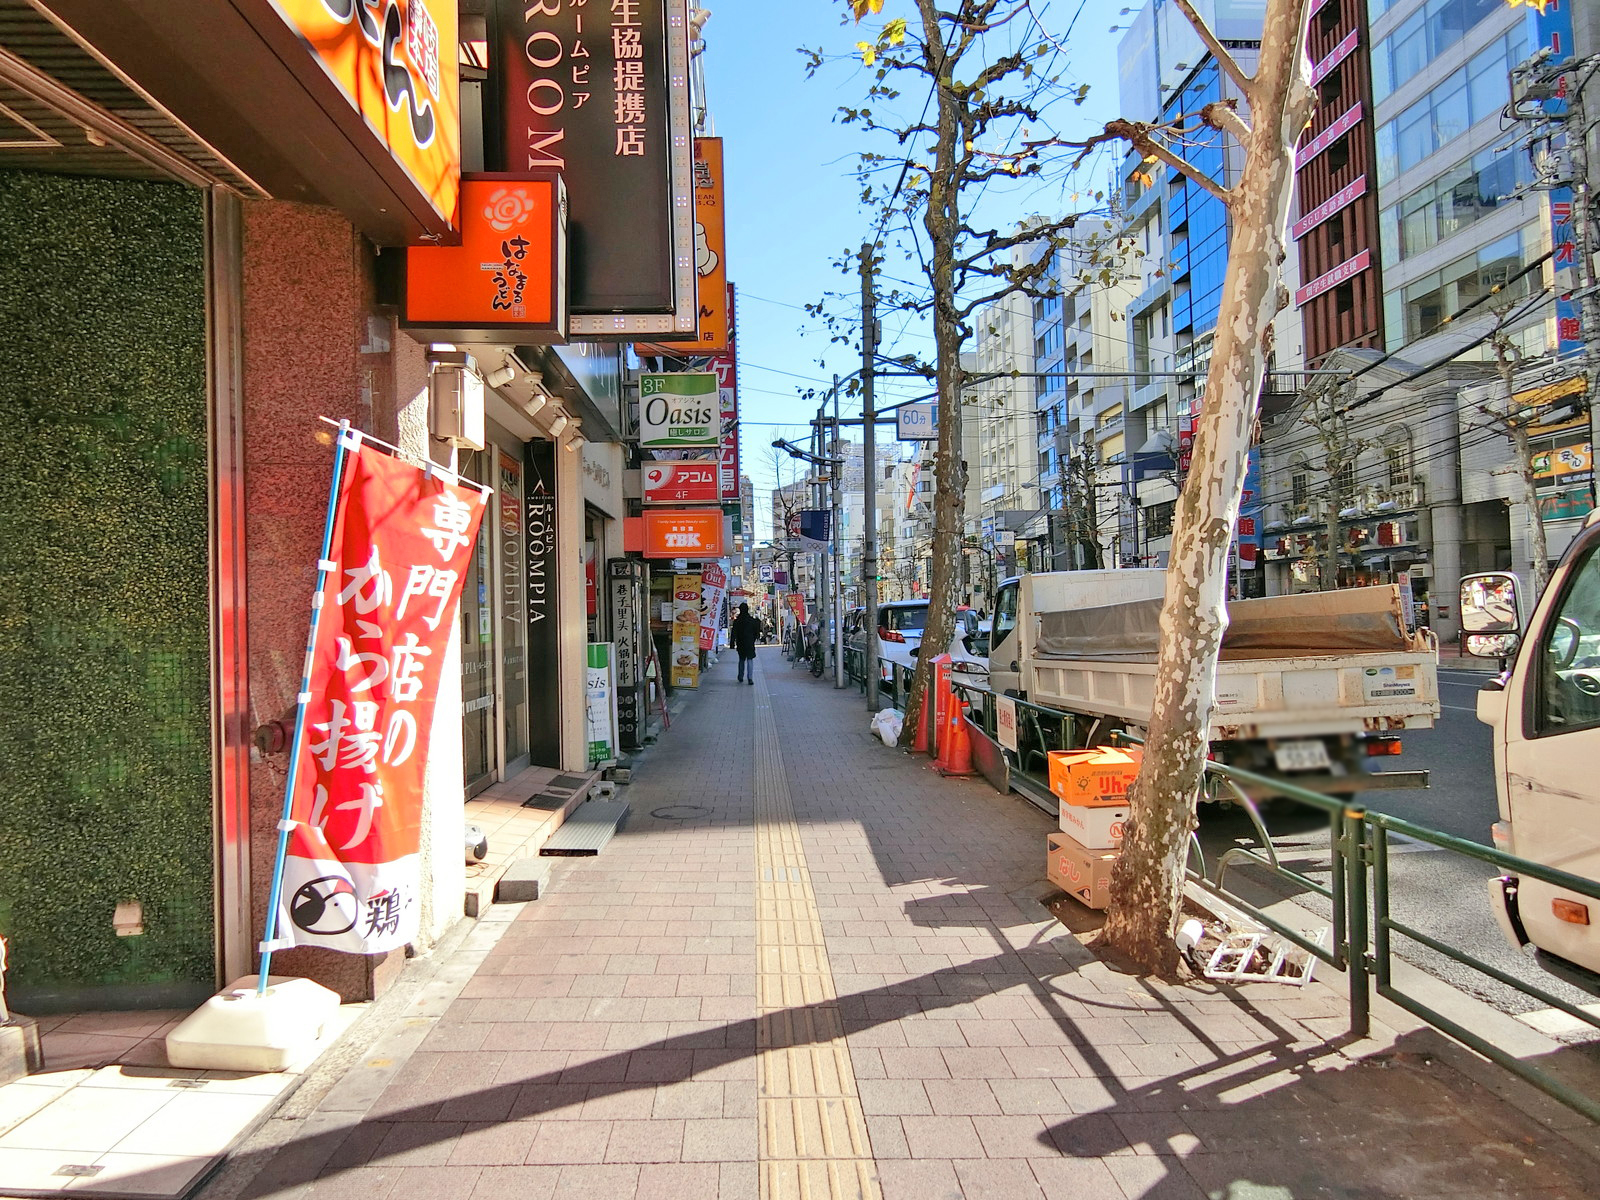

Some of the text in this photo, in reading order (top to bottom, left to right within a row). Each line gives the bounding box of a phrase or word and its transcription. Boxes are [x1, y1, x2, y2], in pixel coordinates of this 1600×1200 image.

[610, 0, 646, 156] 生協提携店
[501, 234, 531, 304] はなまる
[1305, 259, 1358, 298] 留学生就職支援
[491, 271, 512, 311] うどん
[643, 378, 666, 393] 3F
[646, 397, 712, 426] Oasis
[903, 409, 926, 425] 60分
[677, 471, 713, 484] アコム
[675, 491, 689, 499] 4F
[545, 503, 554, 553] ルームピア
[664, 533, 702, 548] TBK
[705, 543, 715, 551] 5F
[528, 503, 546, 624] ROOMPIA
[705, 572, 721, 585] Out
[678, 592, 697, 600] ランチ
[382, 488, 472, 767] 専門店の
[310, 543, 393, 850] から揚げ
[587, 676, 606, 689] sis
[1059, 855, 1080, 883] なし
[363, 887, 401, 940] 鶏
